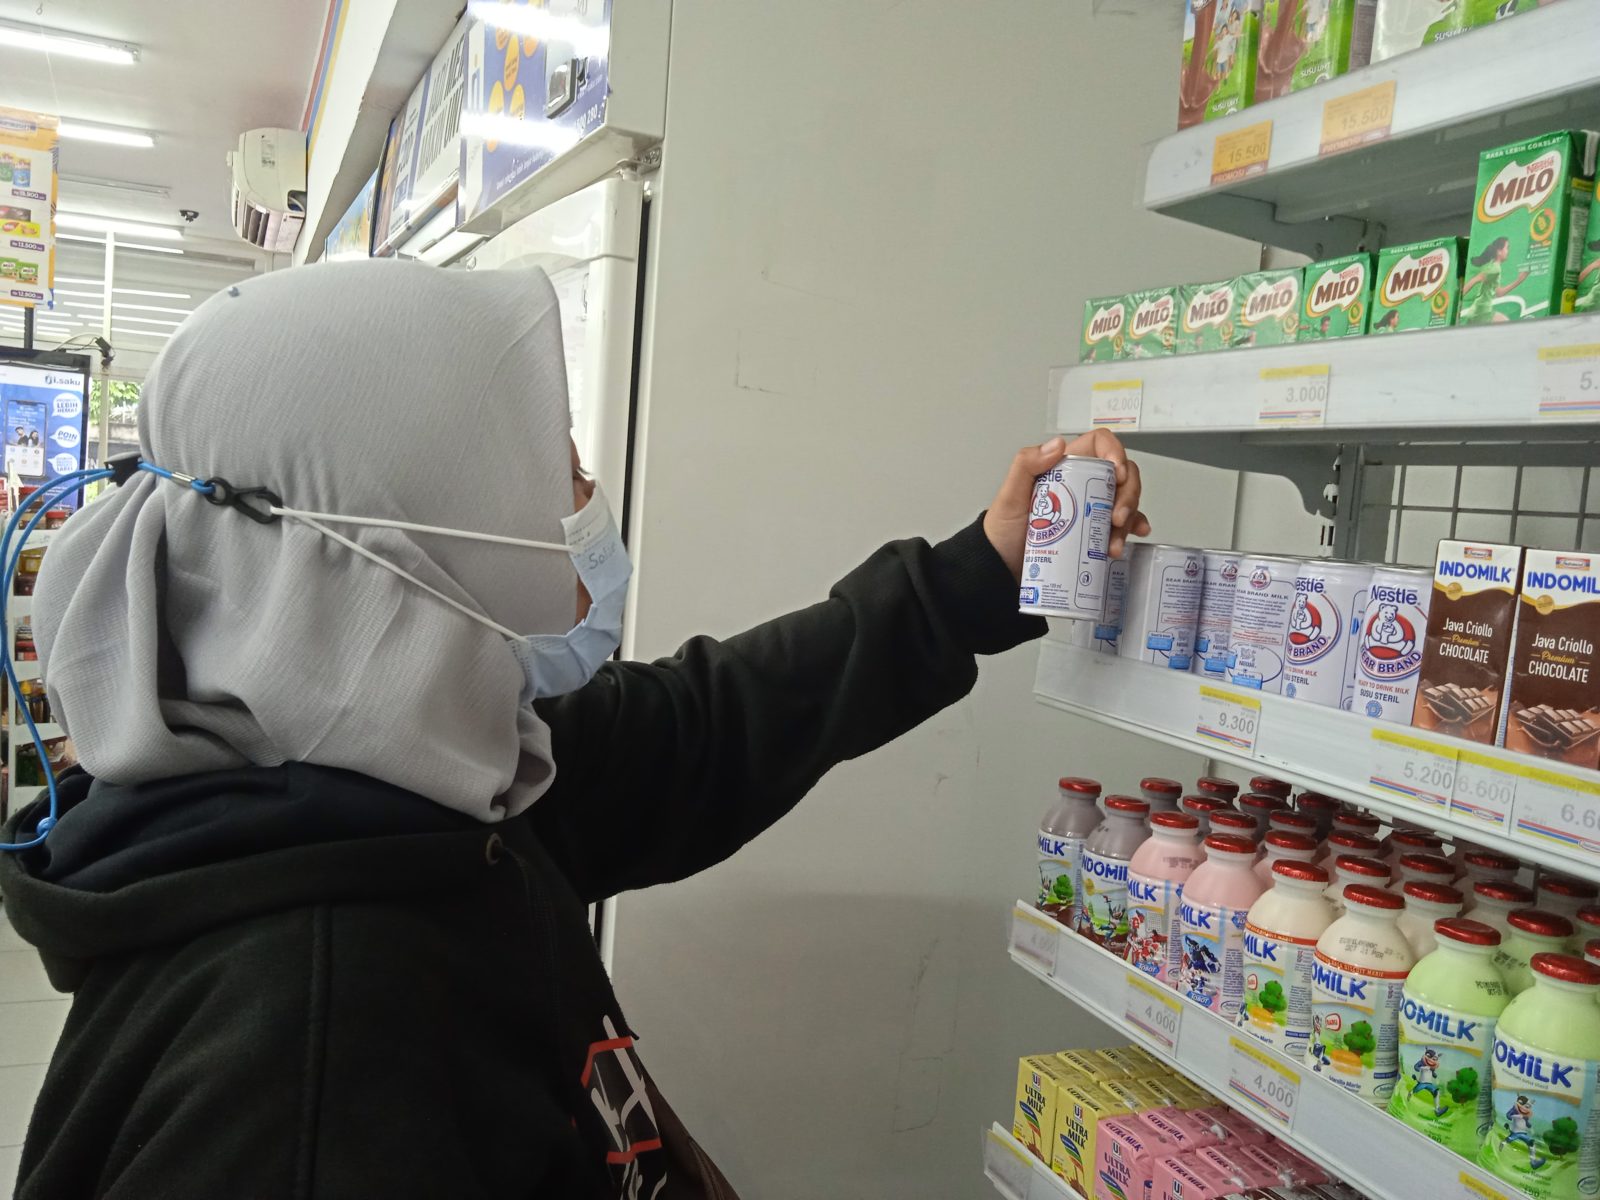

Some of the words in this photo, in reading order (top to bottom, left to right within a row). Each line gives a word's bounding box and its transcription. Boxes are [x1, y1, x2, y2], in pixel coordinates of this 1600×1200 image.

[1342, 105, 1388, 130] 15.500
[1489, 168, 1554, 209] MILO
[1390, 263, 1444, 294] MILO
[1248, 289, 1294, 316] MILO
[1314, 276, 1359, 306] MILO
[1135, 306, 1170, 330] MILO
[1190, 298, 1228, 323] MILO
[1091, 315, 1121, 336] MILO
[1036, 519, 1067, 541] BRAND
[1439, 560, 1511, 584] INDOMILK
[1442, 617, 1464, 633] Java
[1465, 619, 1493, 638] Criollo
[1293, 635, 1328, 657] BRAND
[1452, 634, 1481, 646] Premium
[1531, 633, 1556, 650] Java
[1558, 636, 1593, 655] Criollo
[1377, 650, 1422, 674] BRAND
[1439, 642, 1490, 664] CHOCOLATE
[1541, 651, 1576, 664] Premium
[1291, 674, 1309, 686] STERIL
[1528, 660, 1589, 684] CHOCOLATE
[1374, 692, 1400, 704] STERIL
[1376, 683, 1394, 693] DRINK
[1394, 684, 1410, 695] MILK
[1218, 712, 1255, 735] 9.300
[1403, 761, 1452, 790] 5.200
[1457, 775, 1511, 805] 6.600
[1145, 1005, 1176, 1034] 4.000
[1025, 1084, 1046, 1107] ULTRA
[1254, 1074, 1294, 1108] 4.000
[1026, 1095, 1042, 1116] MILK
[1065, 1115, 1088, 1141] ULTRA
[1068, 1128, 1085, 1150] MILK
[1105, 1122, 1125, 1139] ULTRA
[1125, 1136, 1144, 1153] MILK
[1147, 1114, 1168, 1132] ULTRA
[1168, 1128, 1186, 1142] MILK
[1104, 1152, 1131, 1180] ULTRA
[1107, 1165, 1129, 1188] MILK
[1164, 1159, 1188, 1178] ULTRA
